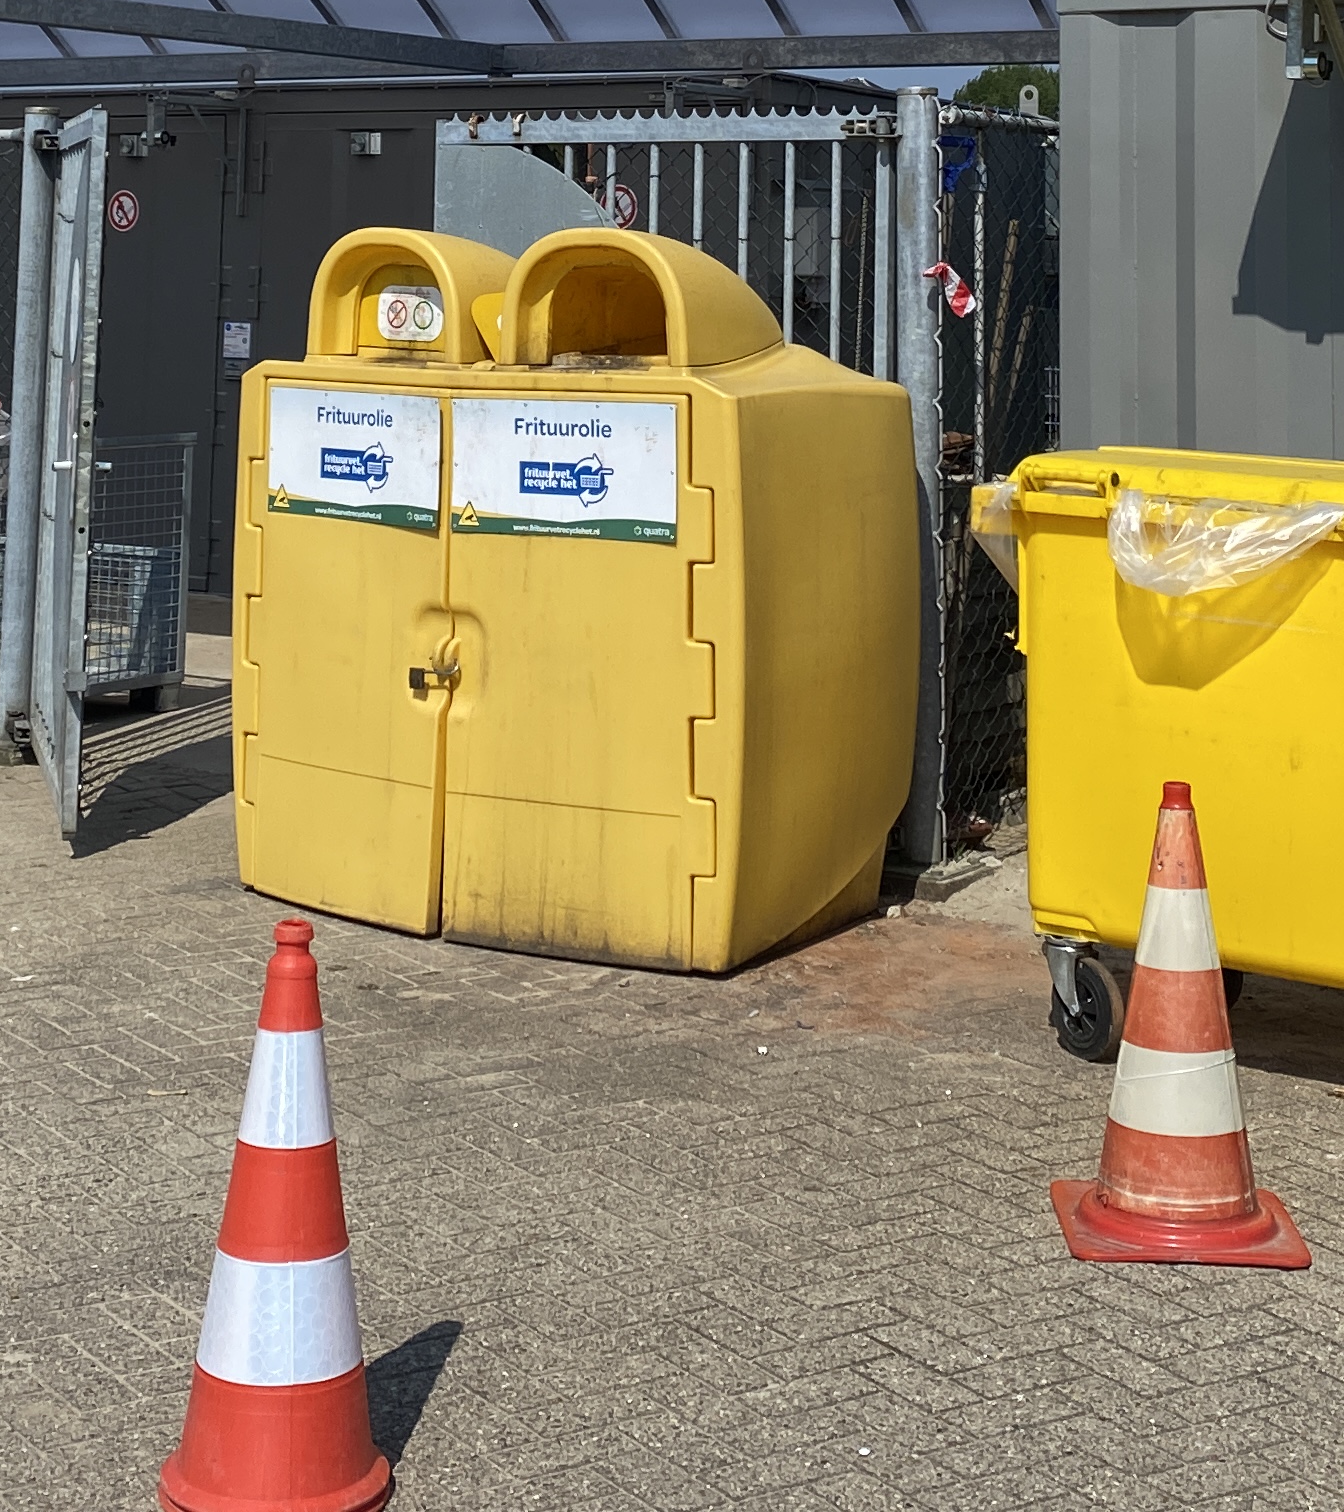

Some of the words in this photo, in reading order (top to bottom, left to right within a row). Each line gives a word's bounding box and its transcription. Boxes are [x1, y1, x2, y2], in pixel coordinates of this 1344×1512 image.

[317, 405, 393, 428] Frituurolie
[514, 416, 613, 438] Frituurolie
[323, 463, 351, 476] recycle
[351, 464, 366, 476] het
[523, 478, 559, 490] recycle
[560, 478, 578, 490] het
